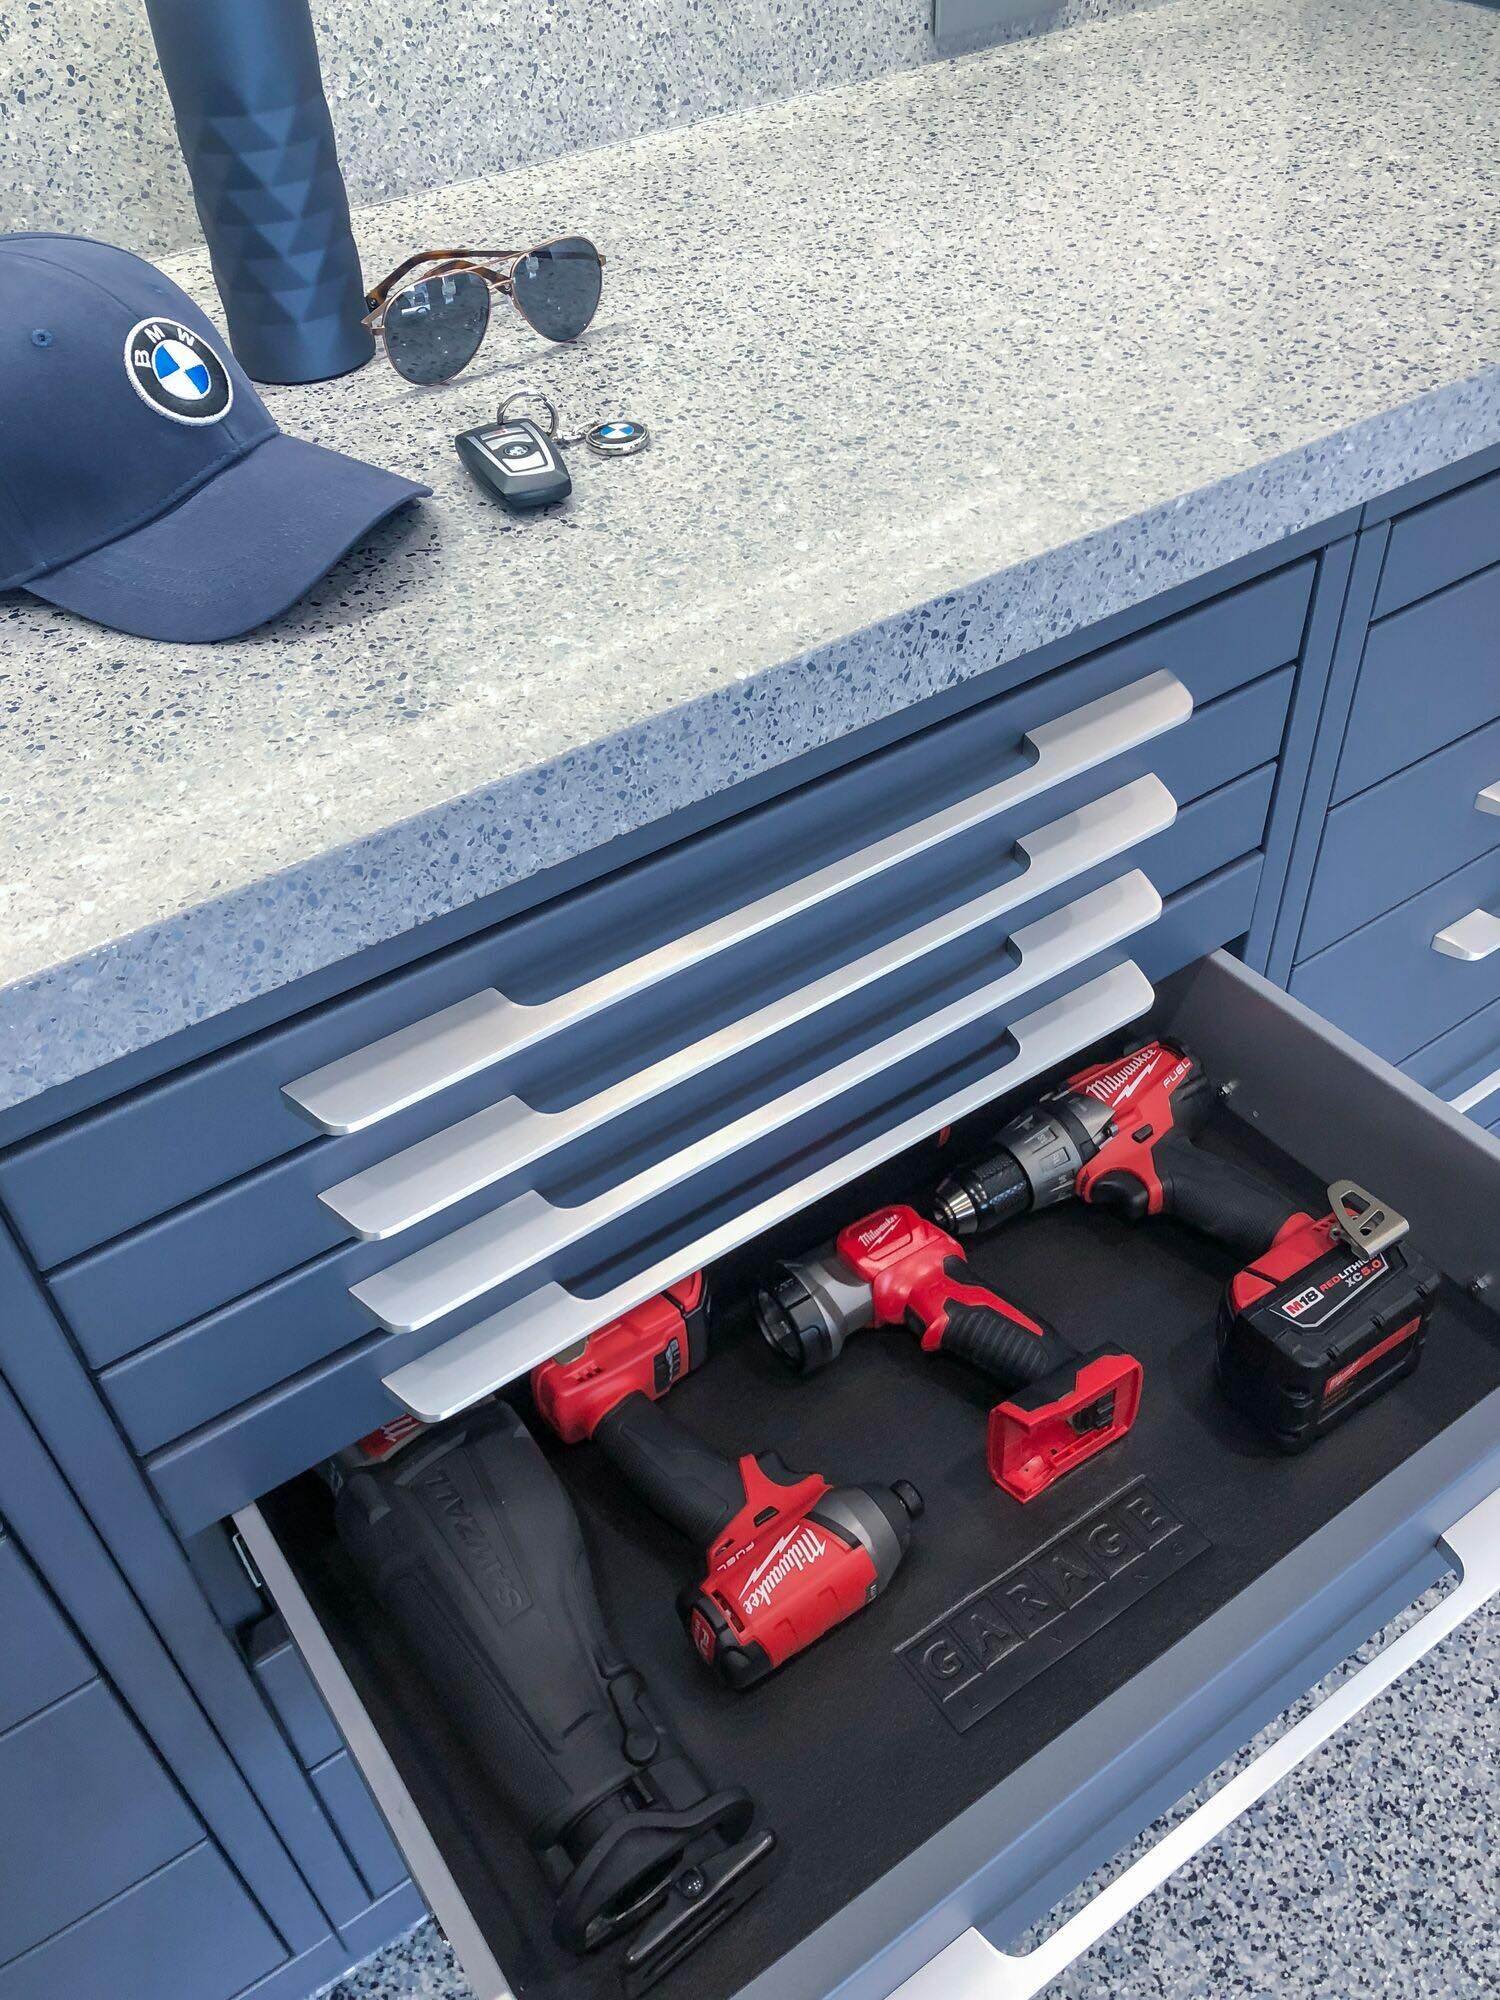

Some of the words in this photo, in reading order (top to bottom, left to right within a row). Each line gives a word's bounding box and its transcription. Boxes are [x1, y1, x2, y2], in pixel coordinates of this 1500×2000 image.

[135, 324, 194, 368] BMW
[1085, 1048, 1157, 1103] Milwaukee
[1162, 1059, 1191, 1088] FUEL
[1345, 1259, 1382, 1288] XC5.0
[1286, 1290, 1318, 1315] M18
[716, 1541, 755, 1571] FUEL
[742, 1527, 827, 1615] Milwaukee
[923, 1496, 1162, 1680] GARAGE
